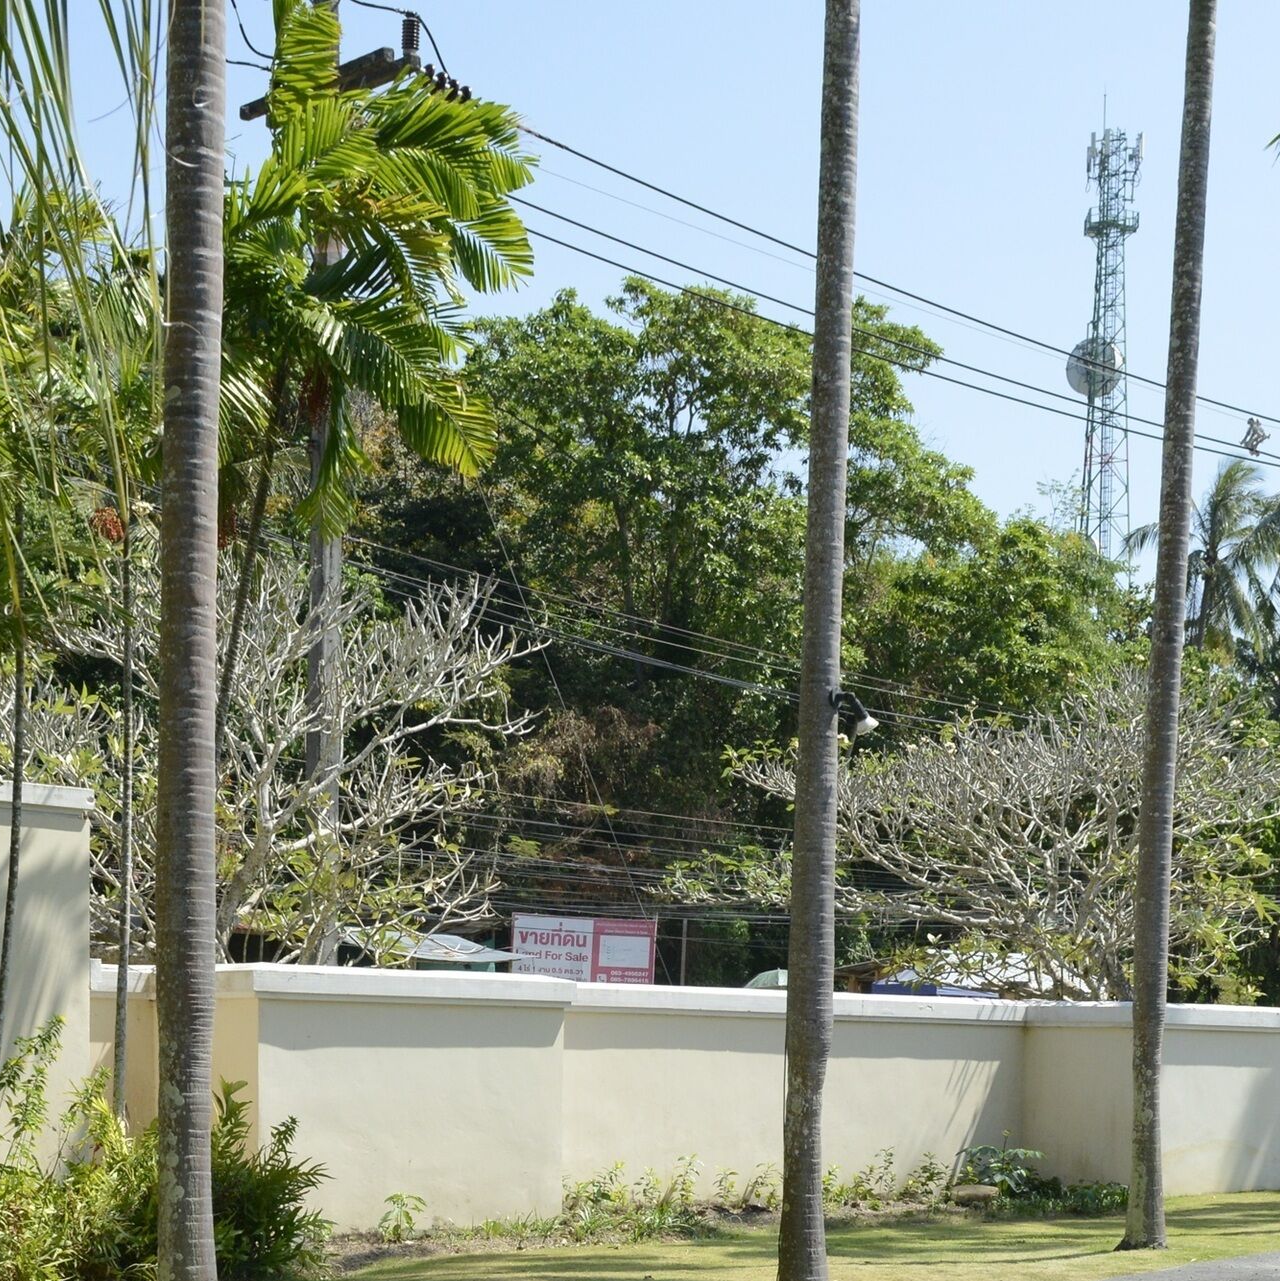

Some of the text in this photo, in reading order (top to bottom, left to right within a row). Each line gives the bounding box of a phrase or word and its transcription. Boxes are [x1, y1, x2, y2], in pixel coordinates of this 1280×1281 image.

[518, 921, 588, 948] ขายที่ดิน
[545, 950, 563, 961] For
[565, 951, 589, 963] Sale
